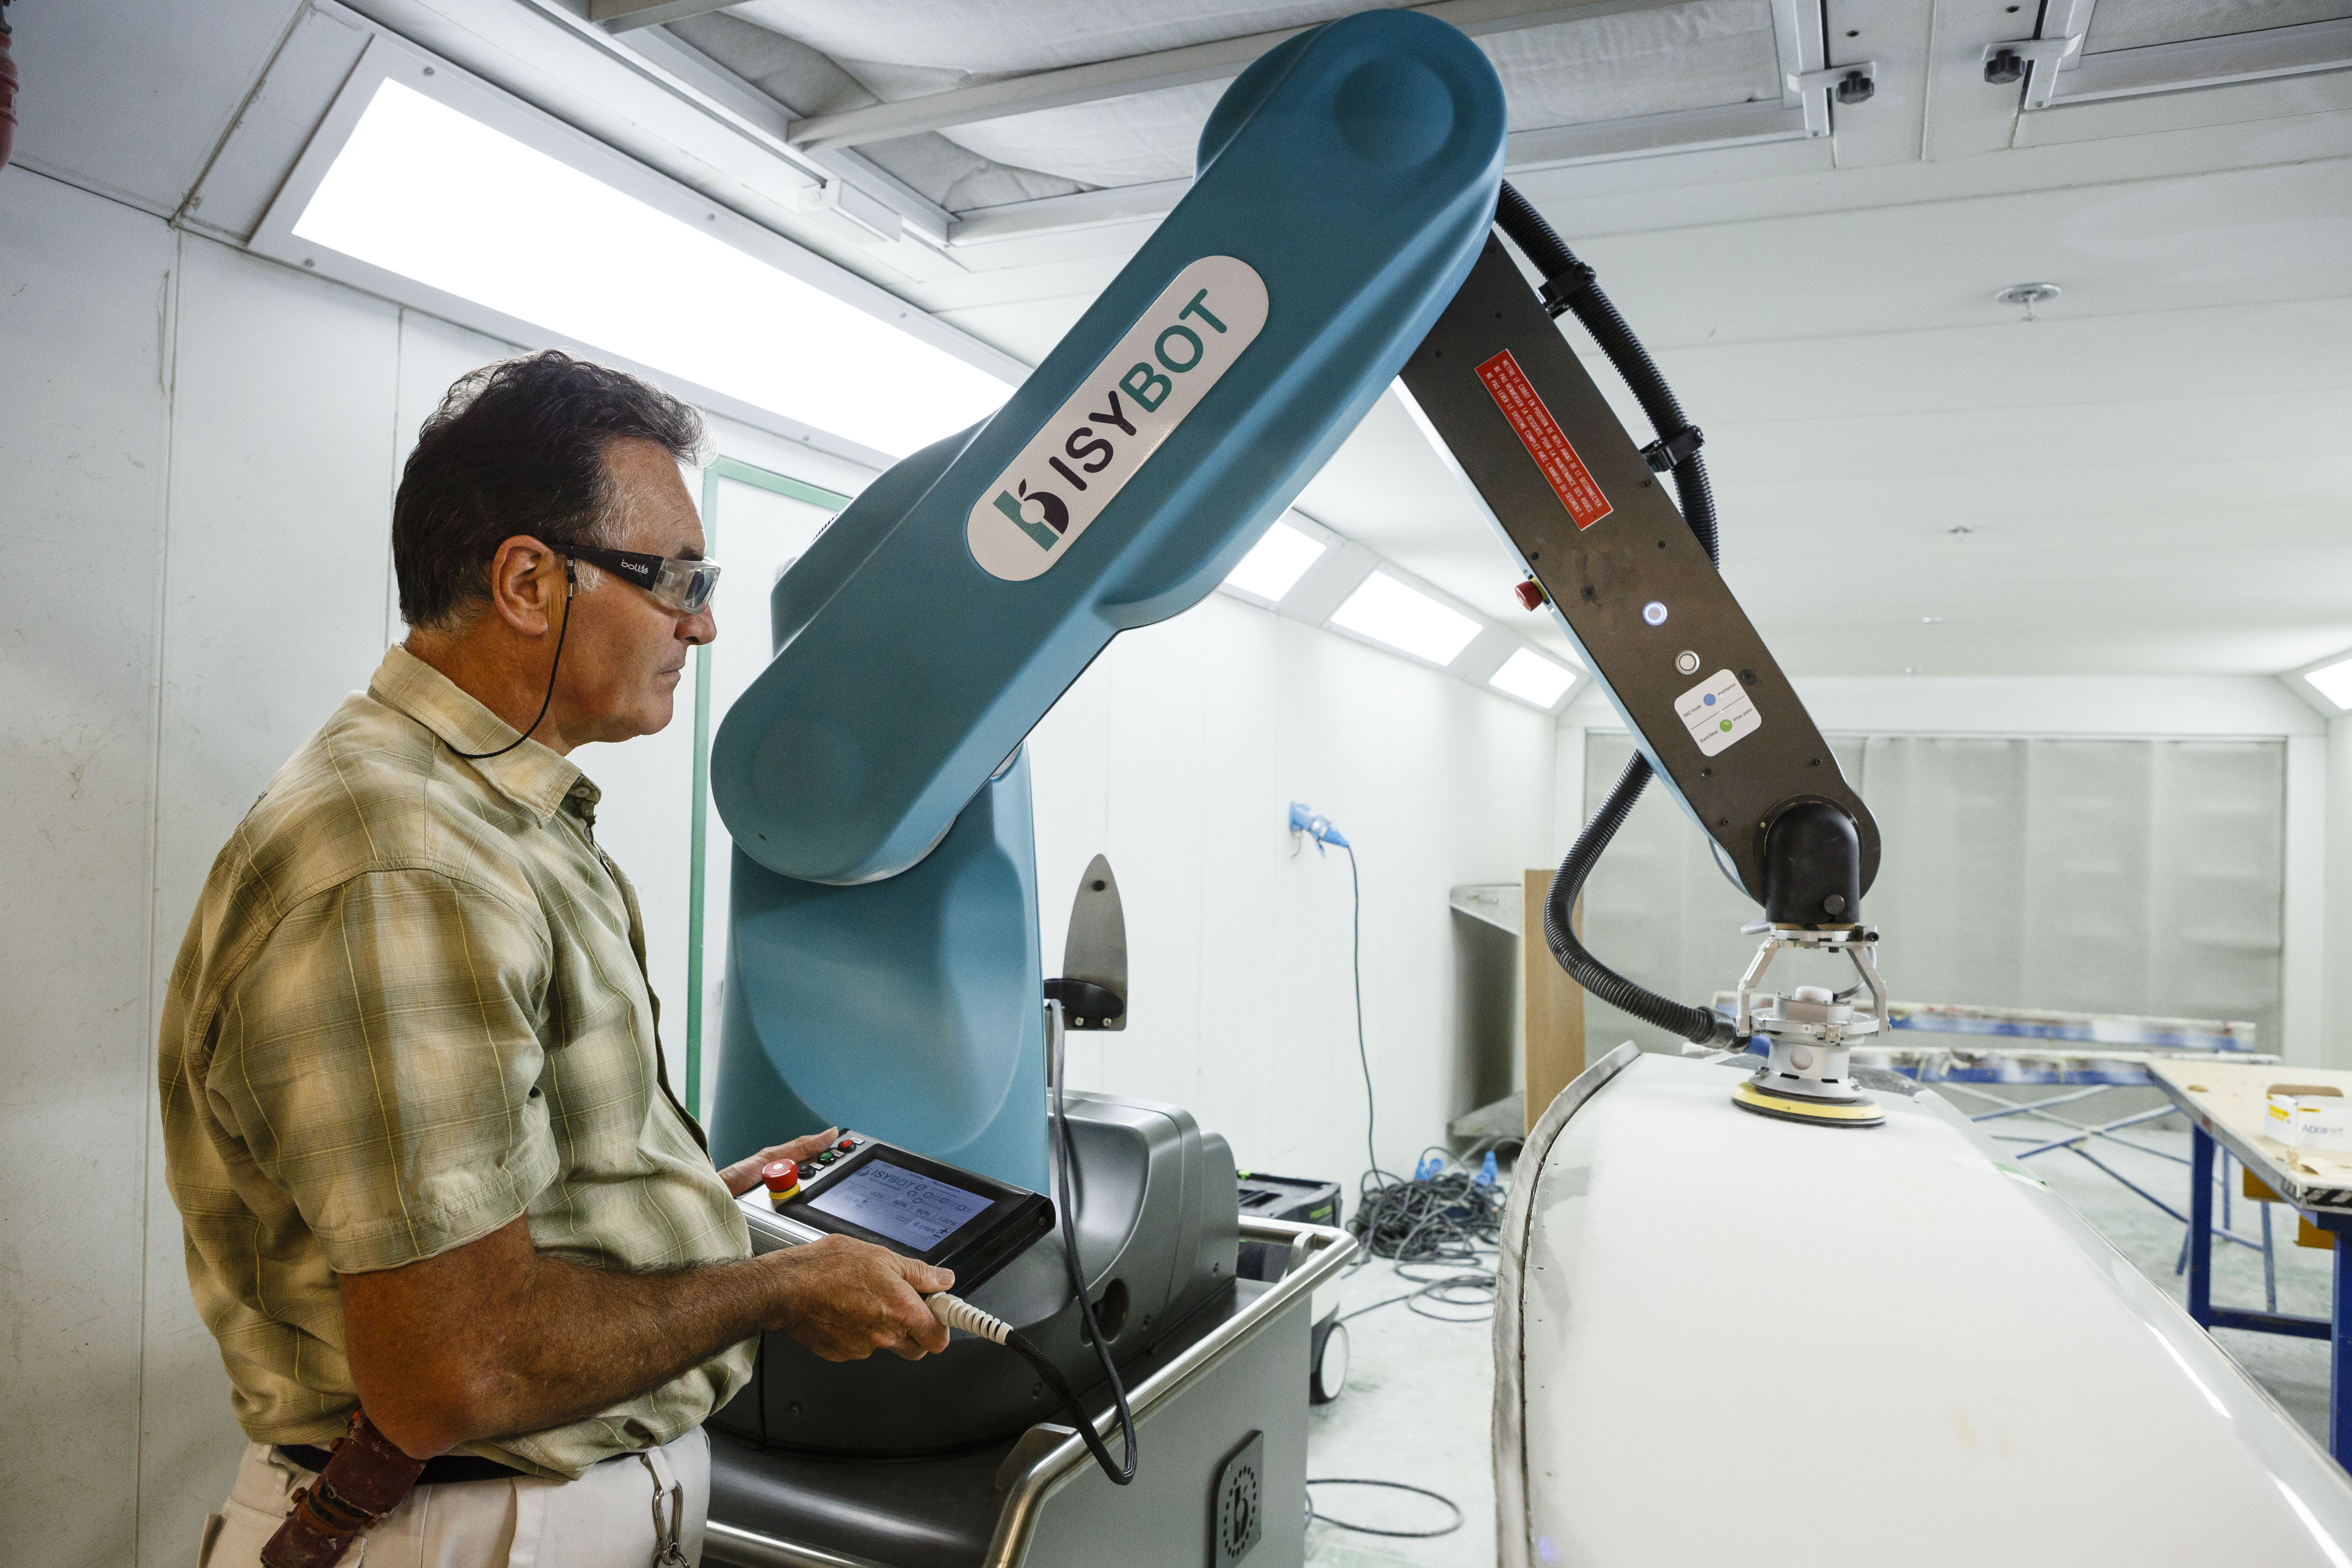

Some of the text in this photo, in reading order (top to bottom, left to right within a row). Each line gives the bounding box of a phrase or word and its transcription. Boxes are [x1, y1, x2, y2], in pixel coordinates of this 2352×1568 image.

[1049, 288, 1227, 491] ISYBOT
[1490, 379, 1500, 390] PAS
[1497, 390, 1509, 403] LEVER
[1511, 410, 1527, 430] SYSTEME
[1524, 430, 1540, 450] COMPLET
[1537, 450, 1548, 463] AVEC
[1560, 484, 1568, 492] DU
[1565, 492, 1581, 512] SEGMENT
[1499, 373, 1508, 383] PAS
[1526, 414, 1543, 437] DESSERTE
[1541, 436, 1552, 450] POUR
[1554, 457, 1576, 486] MAINTENANCE
[1574, 486, 1583, 497] DES
[1502, 359, 1515, 376] METTRE
[1533, 406, 1549, 426] POSITION
[1551, 434, 1563, 448] REPLI
[1560, 448, 1572, 462] AVANT
[870, 1169, 915, 1188] ISYBOT
